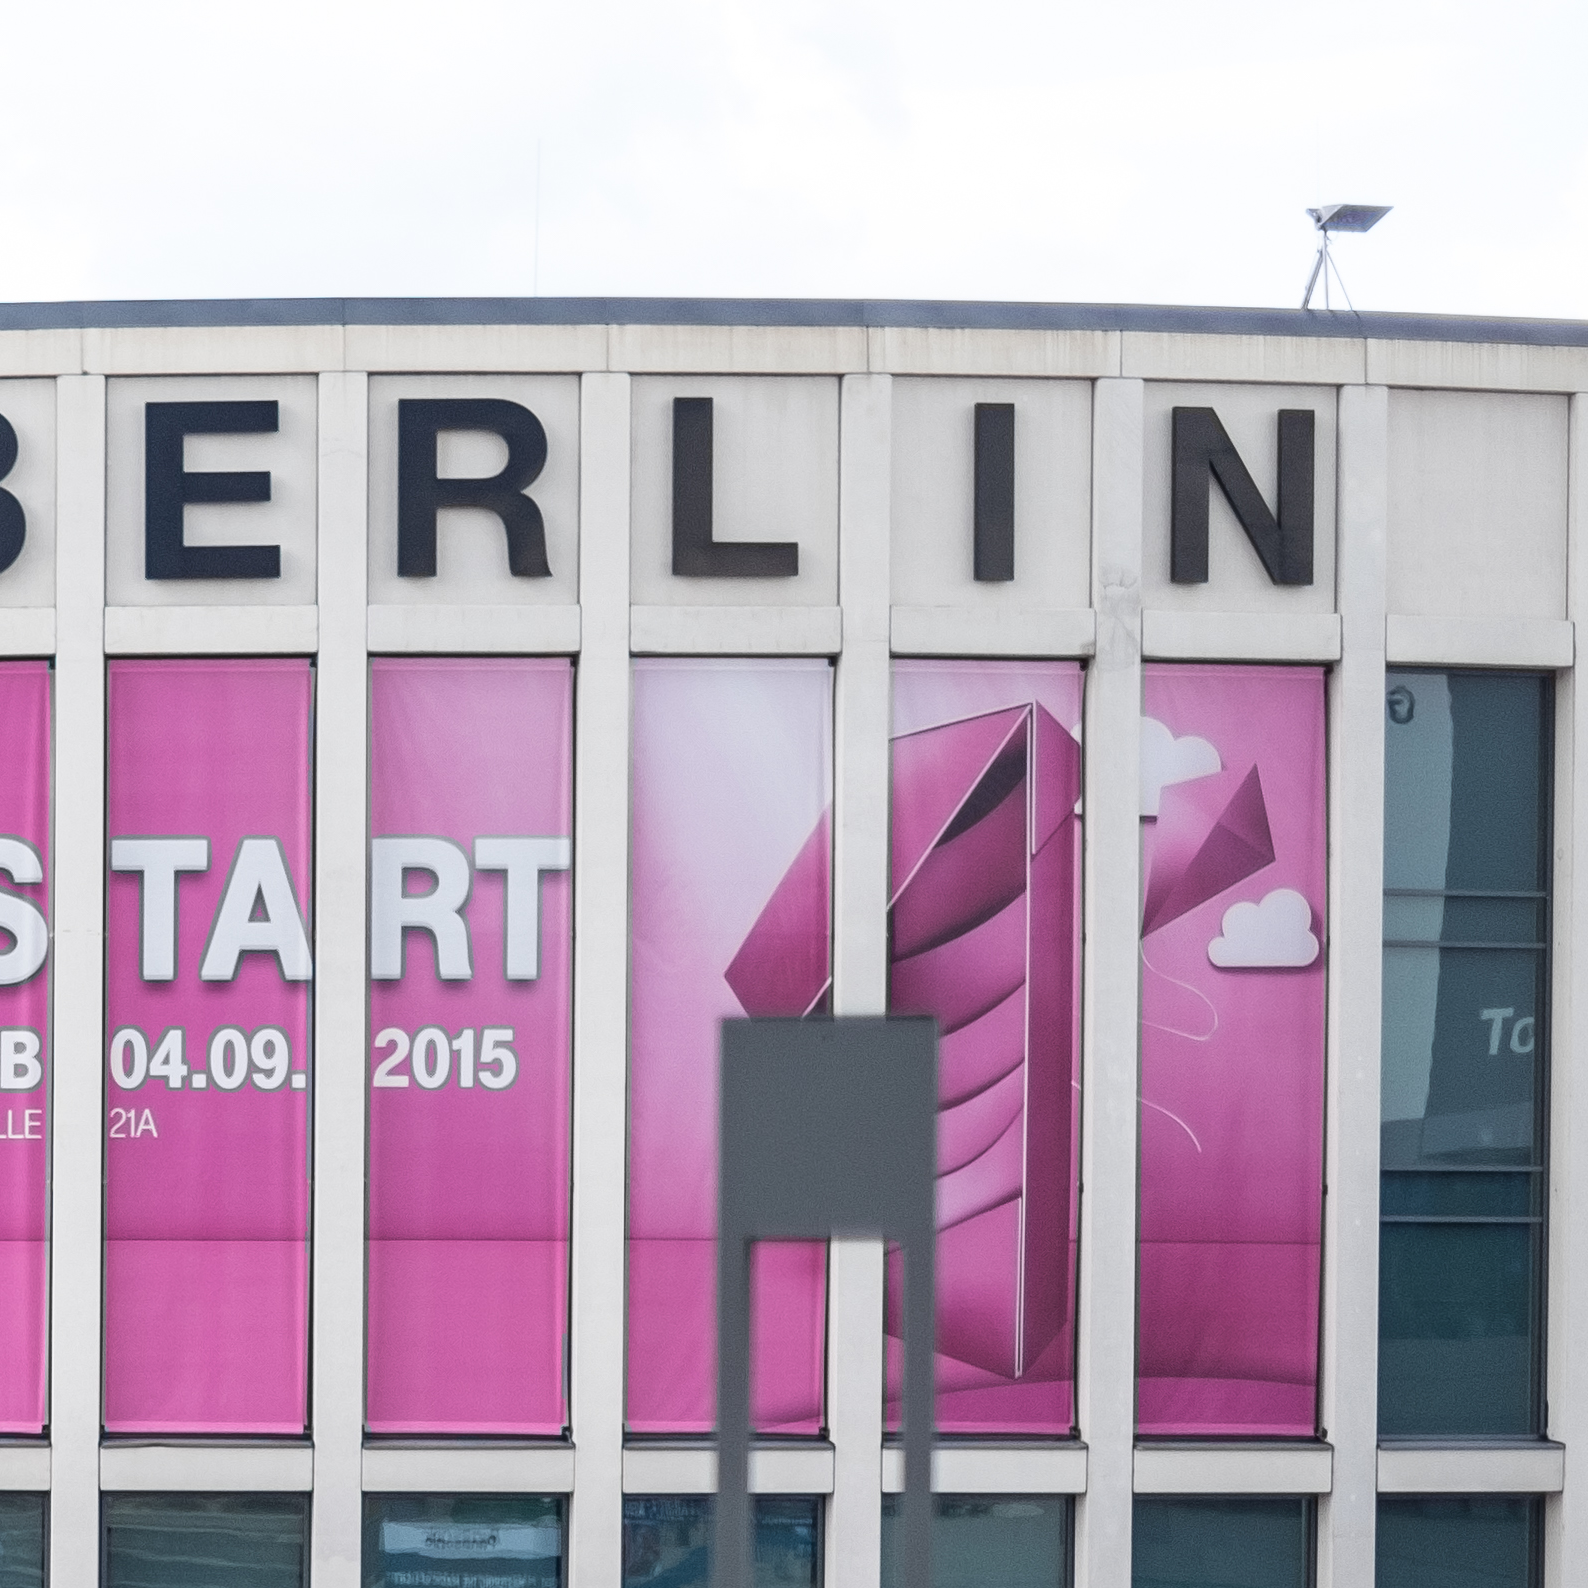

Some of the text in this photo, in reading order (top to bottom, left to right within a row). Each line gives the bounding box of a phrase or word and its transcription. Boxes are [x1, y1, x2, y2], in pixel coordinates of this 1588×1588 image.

[109, 1027, 307, 1090] 04.09.
[373, 1027, 517, 1089] 2015
[109, 1108, 158, 1139] 21A
